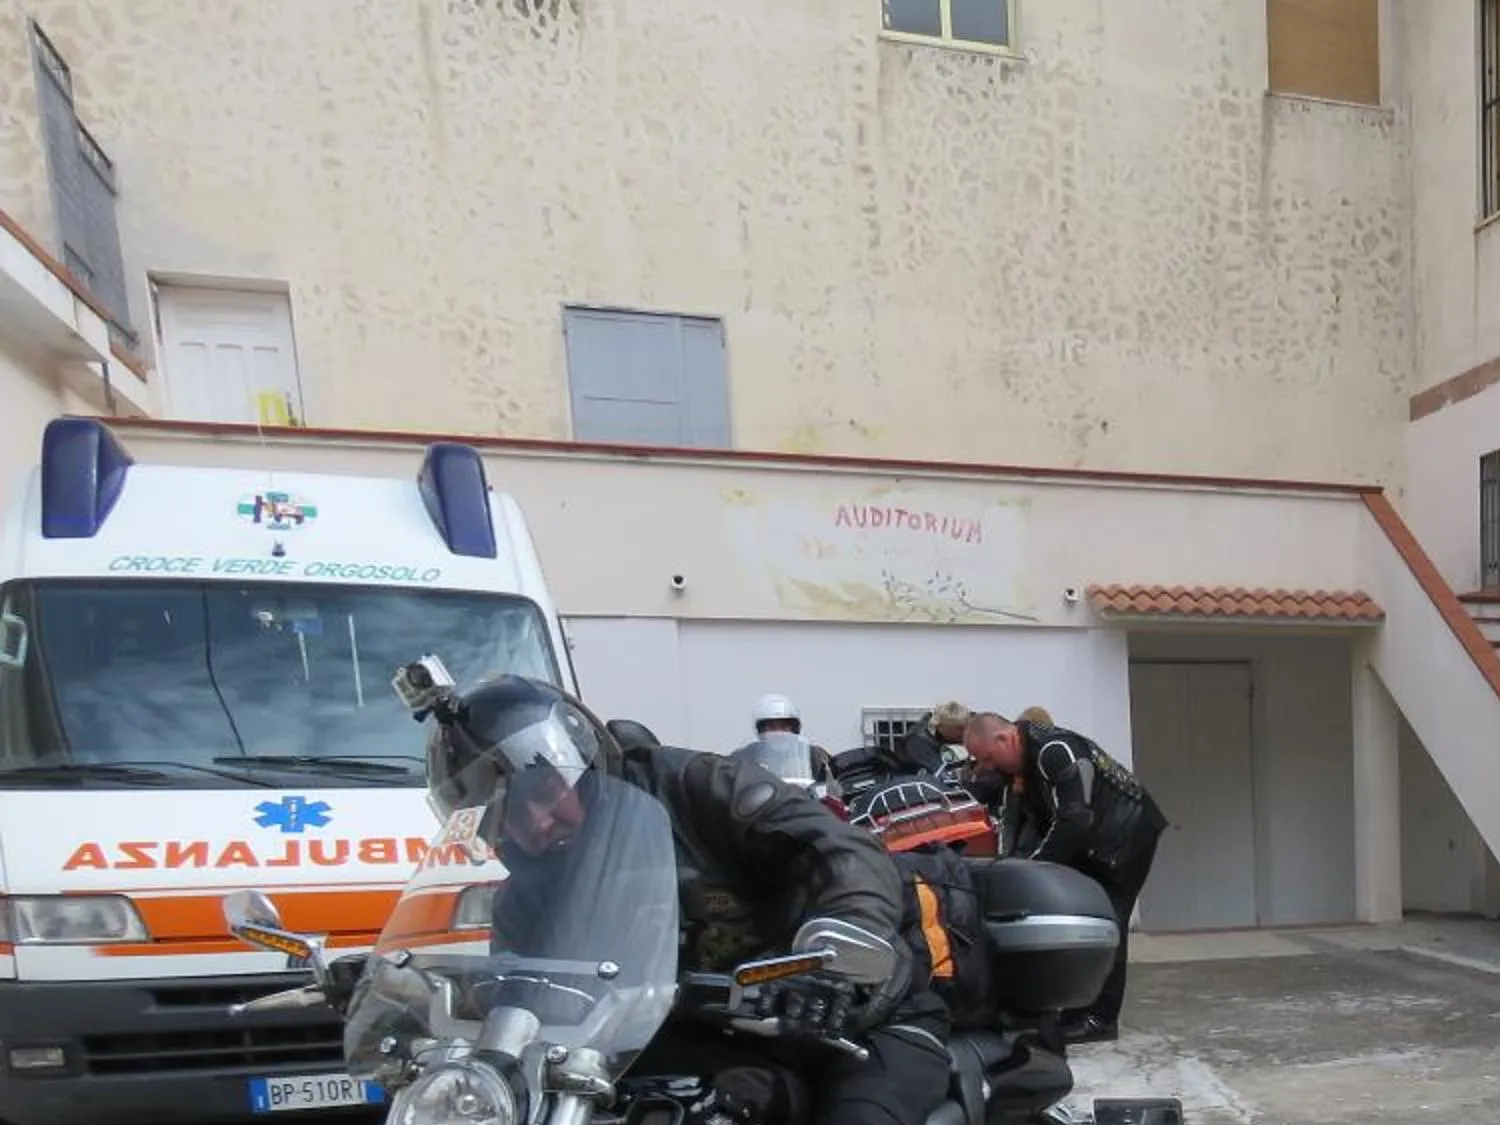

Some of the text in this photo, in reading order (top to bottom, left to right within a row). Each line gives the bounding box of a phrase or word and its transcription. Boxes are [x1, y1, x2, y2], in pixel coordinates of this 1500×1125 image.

[834, 503, 982, 544] AUDITORIUM
[108, 555, 441, 582] CROCE VERDE ORGOSOLO
